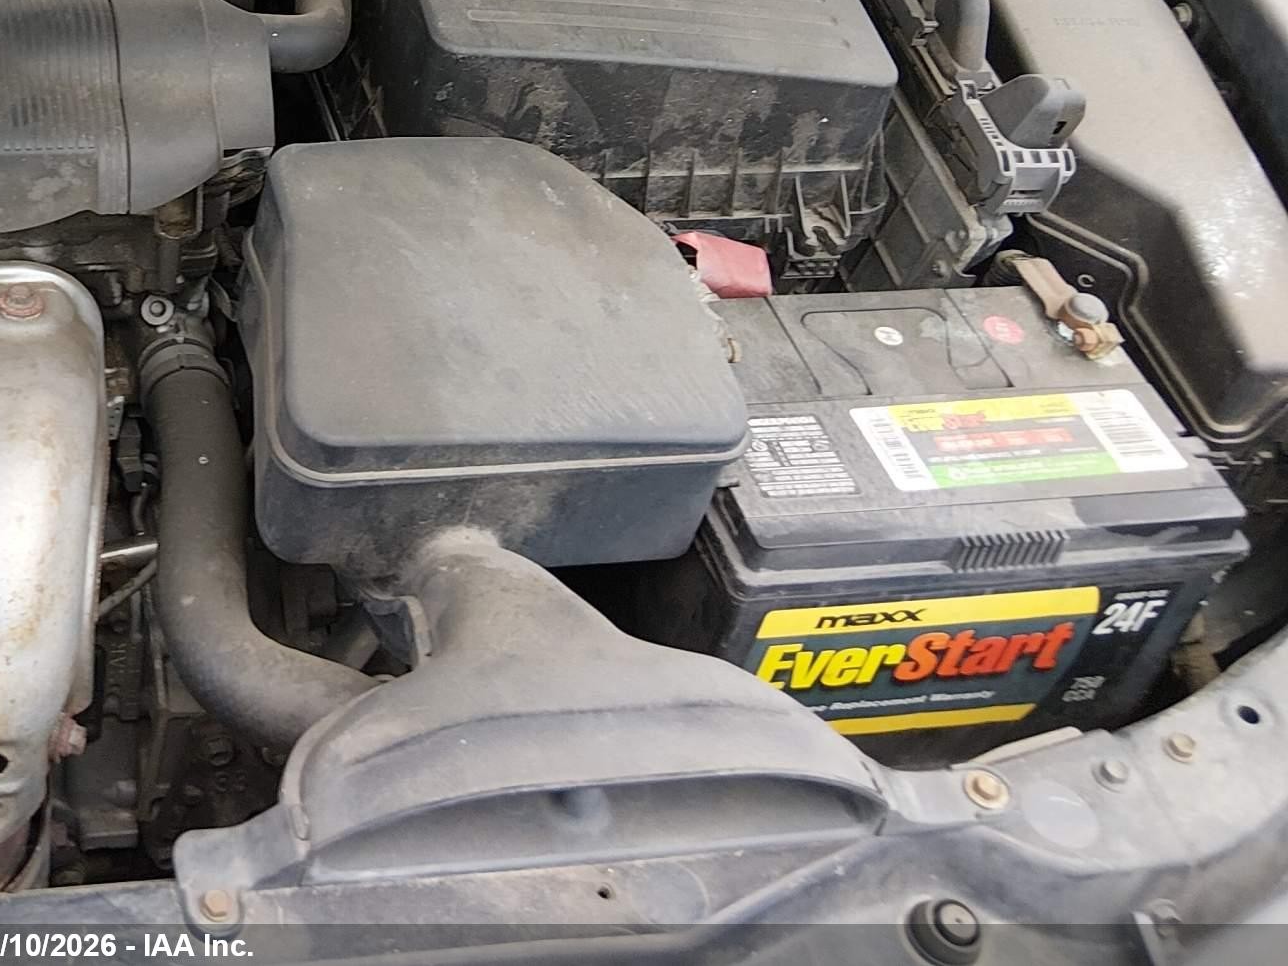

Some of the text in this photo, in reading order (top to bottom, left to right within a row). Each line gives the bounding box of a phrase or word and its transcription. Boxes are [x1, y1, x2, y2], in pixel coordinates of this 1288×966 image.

[815, 608, 927, 629] maxx
[1091, 600, 1167, 635] 24F
[756, 622, 1076, 690] EverStart
